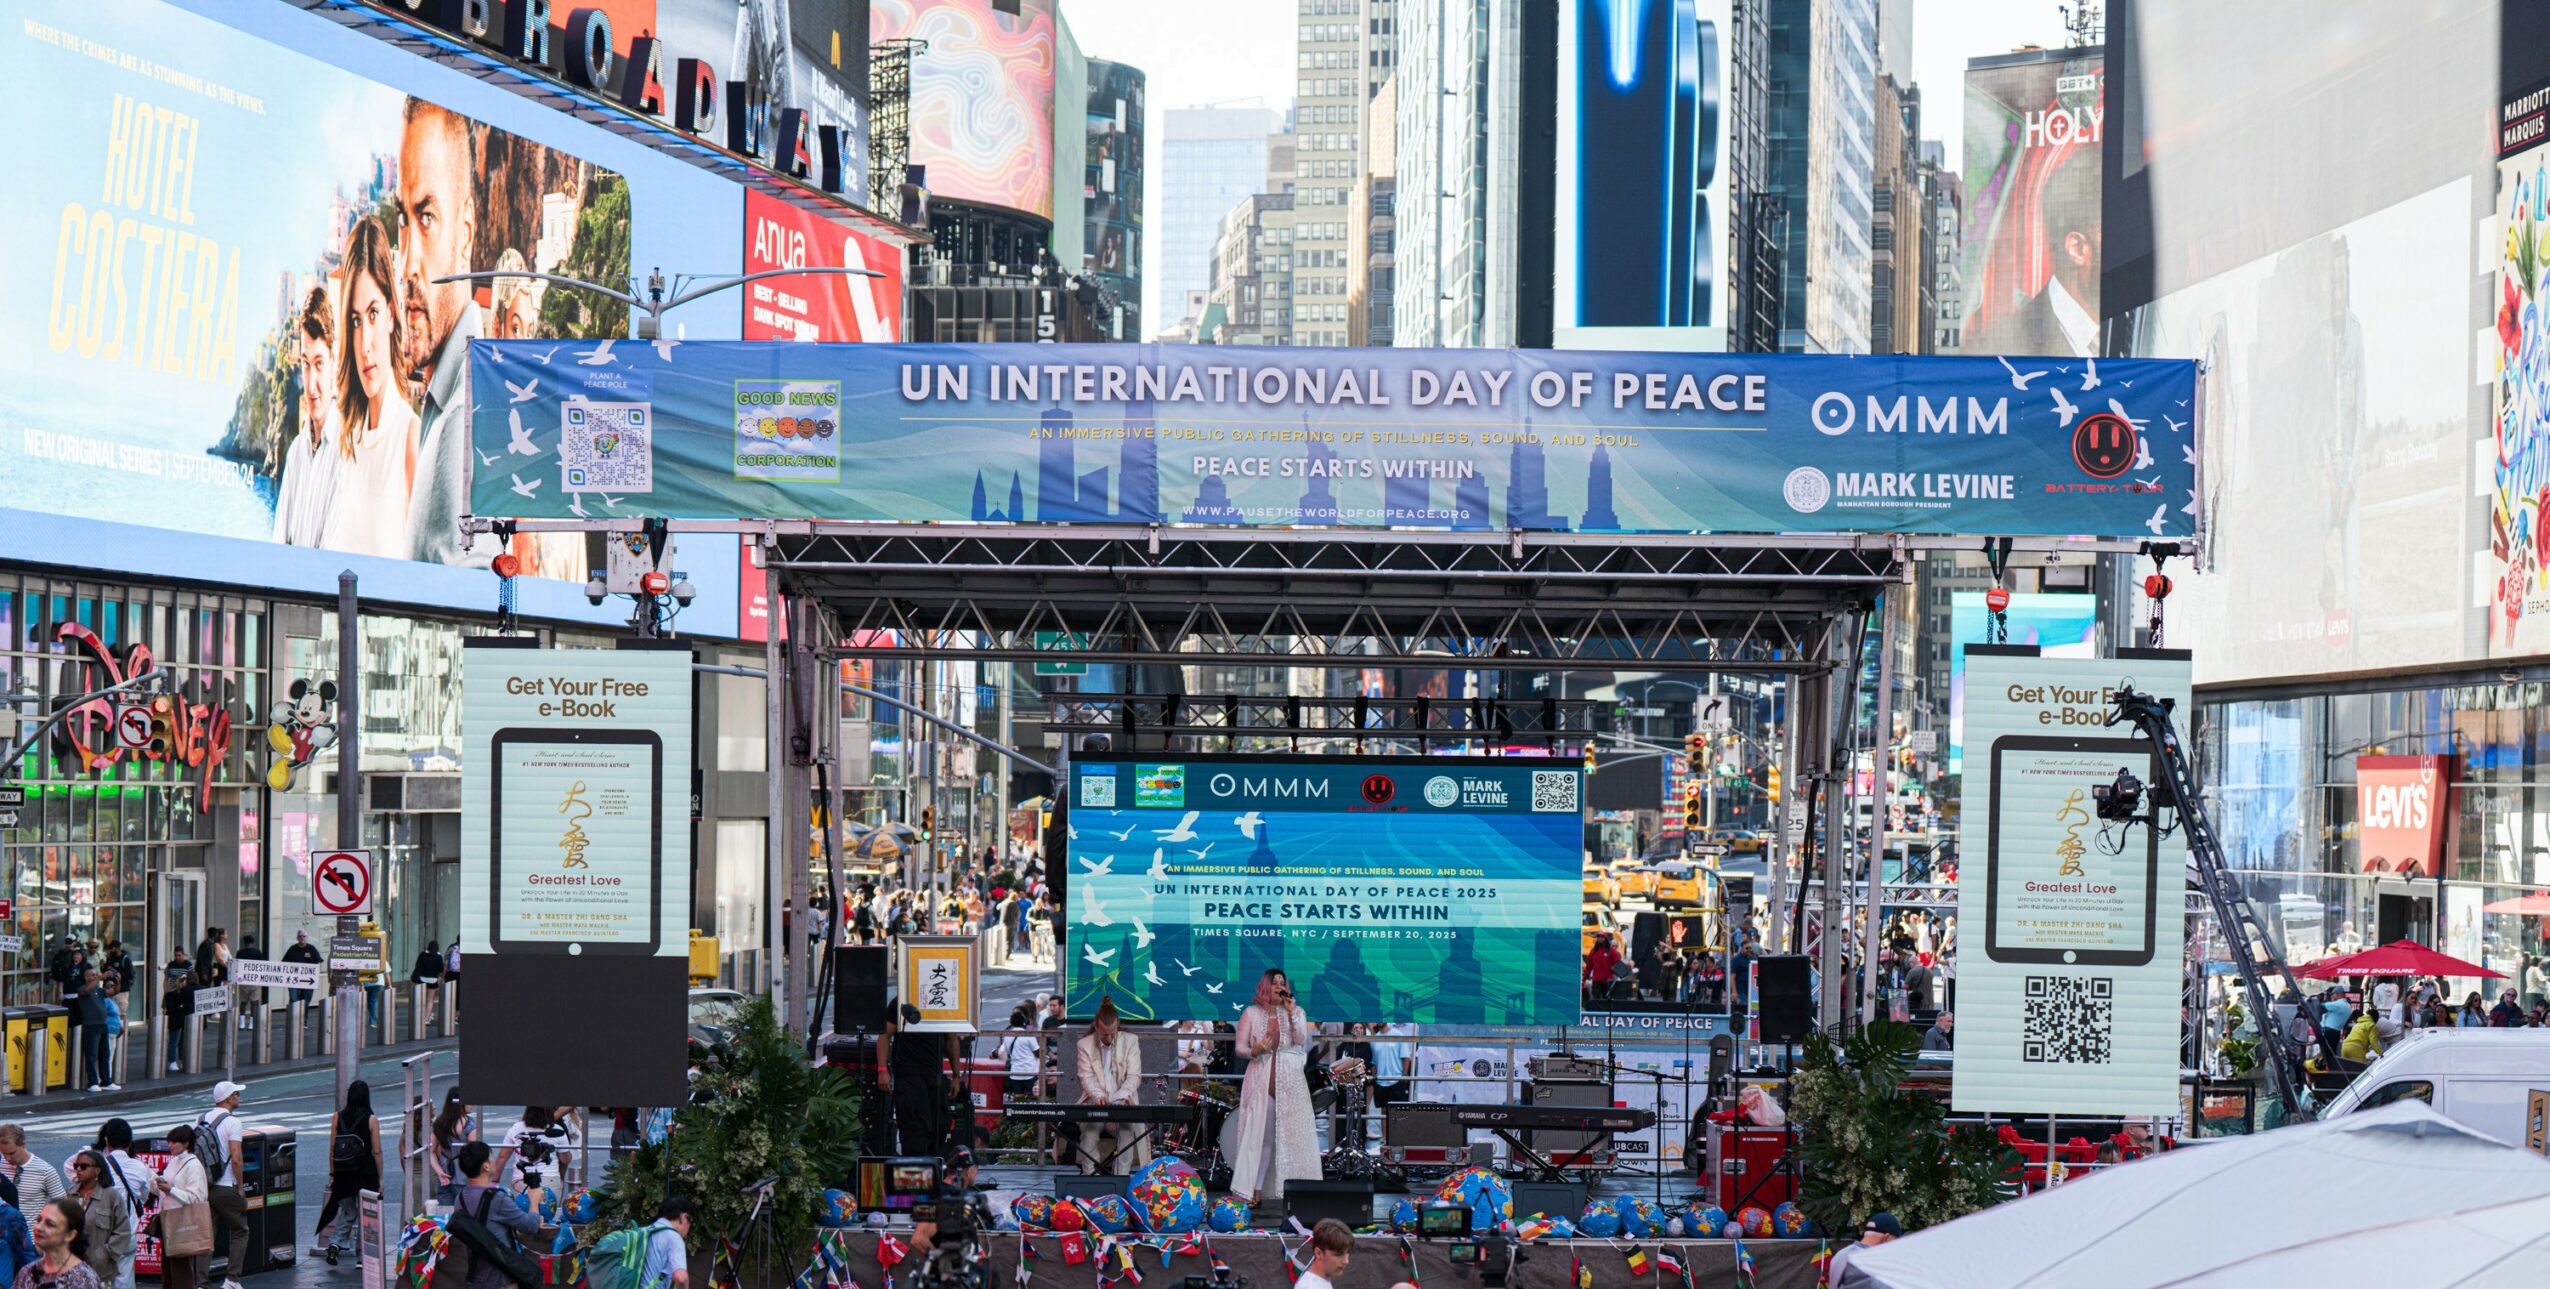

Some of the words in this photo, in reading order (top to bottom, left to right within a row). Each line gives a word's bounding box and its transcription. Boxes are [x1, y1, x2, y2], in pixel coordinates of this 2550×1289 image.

[24, 18, 58, 47] WHERE
[61, 31, 79, 52] THE
[82, 39, 117, 65] CRIMES
[119, 53, 137, 73] ARE
[140, 60, 152, 77] AS
[155, 64, 202, 94] STUNNING
[205, 82, 217, 99] AS
[219, 86, 235, 105] THE
[235, 92, 267, 116] VIEWS.
[2025, 105, 2104, 148] HOLY
[2504, 115, 2544, 147] MARQUIS
[102, 92, 199, 226] HOTEL
[754, 216, 805, 276] Anua
[50, 202, 240, 384] COSTIERA
[775, 312, 794, 331] SPOT
[1038, 290, 1056, 343] 15
[590, 372, 612, 380] PLANT
[584, 381, 606, 389] PEACE
[608, 381, 628, 389] POLE
[902, 364, 968, 400] UN
[991, 365, 1389, 405] INTERNATIONAL
[1411, 369, 1512, 406] DAY
[1530, 370, 1593, 408] OF
[1614, 373, 1766, 411] PEACE
[738, 391, 784, 406] GOOD
[789, 392, 836, 406] NEWS
[1029, 427, 1053, 439] AN
[1059, 426, 1155, 440] IMMERSIVE
[1161, 428, 1224, 441] PUBLIC
[1231, 429, 1334, 442] GATHERING
[1341, 431, 1364, 444] OF
[1372, 431, 1474, 445] STILLNESS,
[1480, 432, 1543, 446] SOUND,
[1552, 433, 1585, 446] AND
[1593, 434, 1638, 447] SOUL
[24, 427, 55, 458] NEW
[57, 433, 118, 471] ORIGINAL
[119, 443, 162, 476] SERIES
[172, 453, 239, 487] SEPTEMBER
[240, 463, 255, 489] 24
[737, 454, 835, 468] CORPORATION
[1193, 457, 1275, 477] PEACE
[1279, 458, 1373, 478] STARTS
[1383, 460, 1473, 479] WITHIN
[1837, 472, 1917, 498] MARK
[1924, 474, 2014, 499] LEVINE
[1183, 506, 1470, 520] WWW.PAUSETHEWORLDFORPEACE.ORG
[506, 676, 544, 696] Get
[549, 677, 598, 696] Your
[602, 678, 648, 697] Free
[2007, 684, 2044, 703] Get
[2049, 686, 2098, 705] Your
[539, 700, 616, 718] e-Book
[1702, 722, 1723, 730] ONLY
[1210, 773, 1329, 798] OMMM
[1463, 780, 1502, 792] MARK
[1463, 792, 1508, 804] LEVINE
[1788, 819, 1805, 831] 25
[1167, 865, 1180, 873] AN
[1183, 865, 1236, 874] IMMERSIVE
[1238, 866, 1271, 874] PUBLIC
[1274, 866, 1326, 875] GATHERING
[1330, 867, 1342, 875] OF
[1345, 867, 1396, 876] STILLNESS,
[1399, 868, 1434, 877] SOUND,
[1437, 868, 1457, 876] AND
[529, 874, 585, 885] Greatest
[591, 875, 621, 886] Love
[2025, 881, 2082, 893] Greatest
[2087, 883, 2117, 894] Love
[1154, 884, 1176, 894] UN
[1184, 885, 1318, 896] INTERNATIONAL
[1326, 887, 1359, 897] DAY
[1368, 887, 1389, 897] OF
[1397, 887, 1449, 898] PEACE
[1457, 888, 1497, 899] 2025
[1205, 903, 1272, 918] PEACE
[1280, 904, 1361, 919] STARTS
[1369, 905, 1448, 920] WITHIN
[1193, 928, 1230, 936] TIMES
[1235, 928, 1287, 938] SQUARE,
[1292, 929, 1317, 937] NYC
[1333, 930, 1401, 939] SEPTEMBER
[1405, 931, 1423, 940] 20,
[1428, 931, 1457, 939] 2025
[244, 963, 281, 973] PEDESTRIAN
[283, 966, 299, 974] FLOW
[301, 967, 316, 975] ZONE
[243, 974, 258, 982] KEEP
[260, 975, 283, 984] MOVING
[1605, 1016, 1634, 1028] DAY
[1641, 1017, 1660, 1028] OF
[1666, 1018, 1712, 1030] PEACE
[1465, 1112, 1486, 1120] YAMAHA
